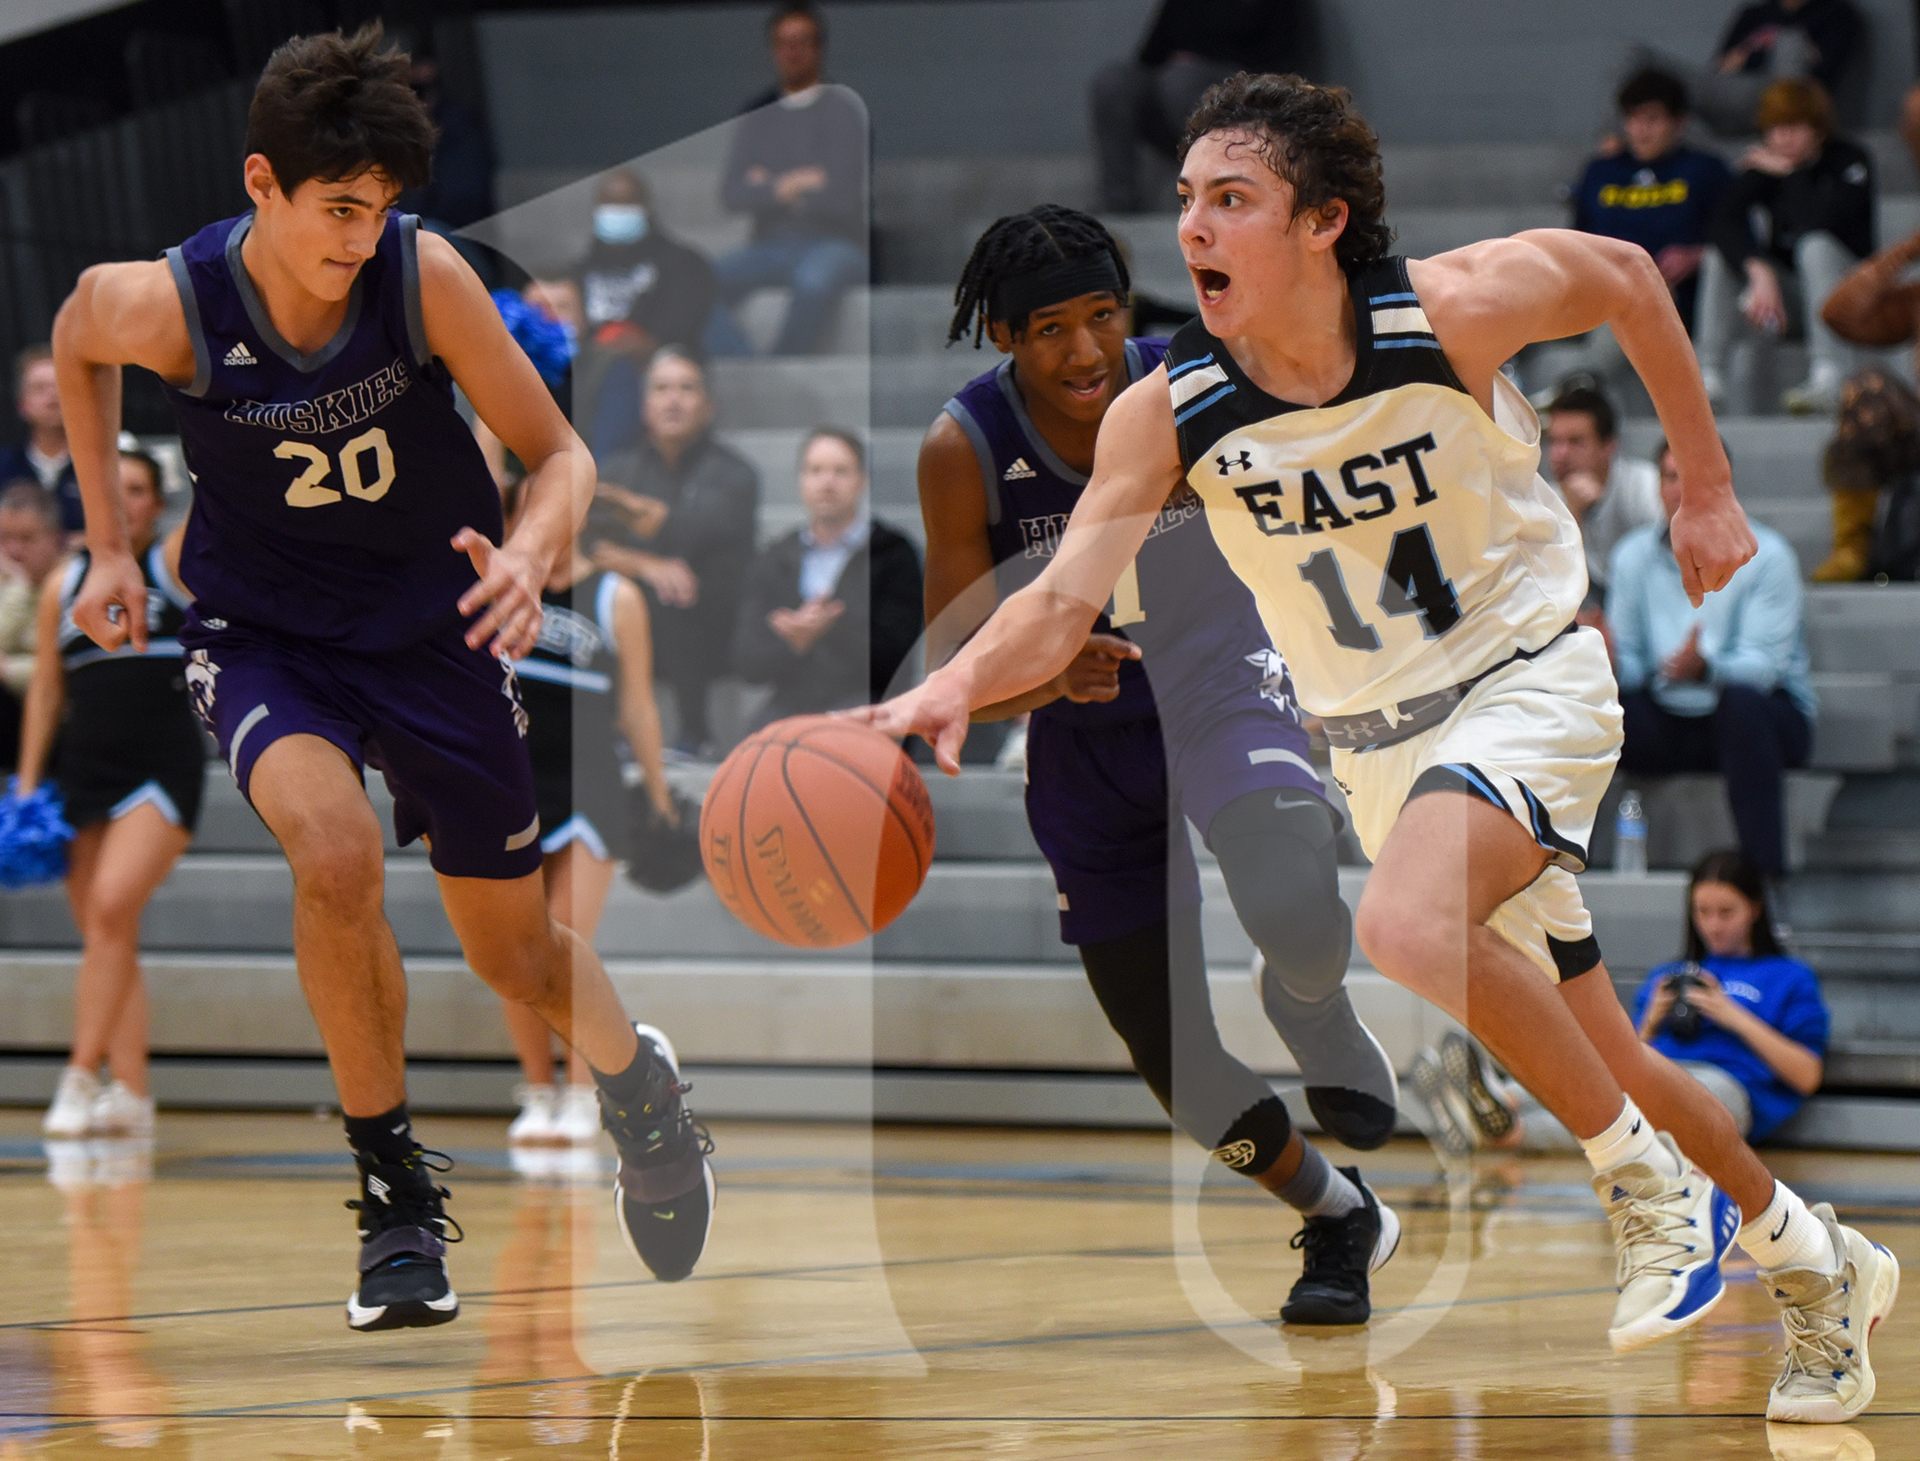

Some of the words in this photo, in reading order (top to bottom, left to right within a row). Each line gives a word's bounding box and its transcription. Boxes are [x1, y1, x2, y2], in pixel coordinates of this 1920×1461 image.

[272, 426, 397, 508] 20
[1232, 431, 1439, 537] EAST
[1296, 522, 1464, 653] 14
